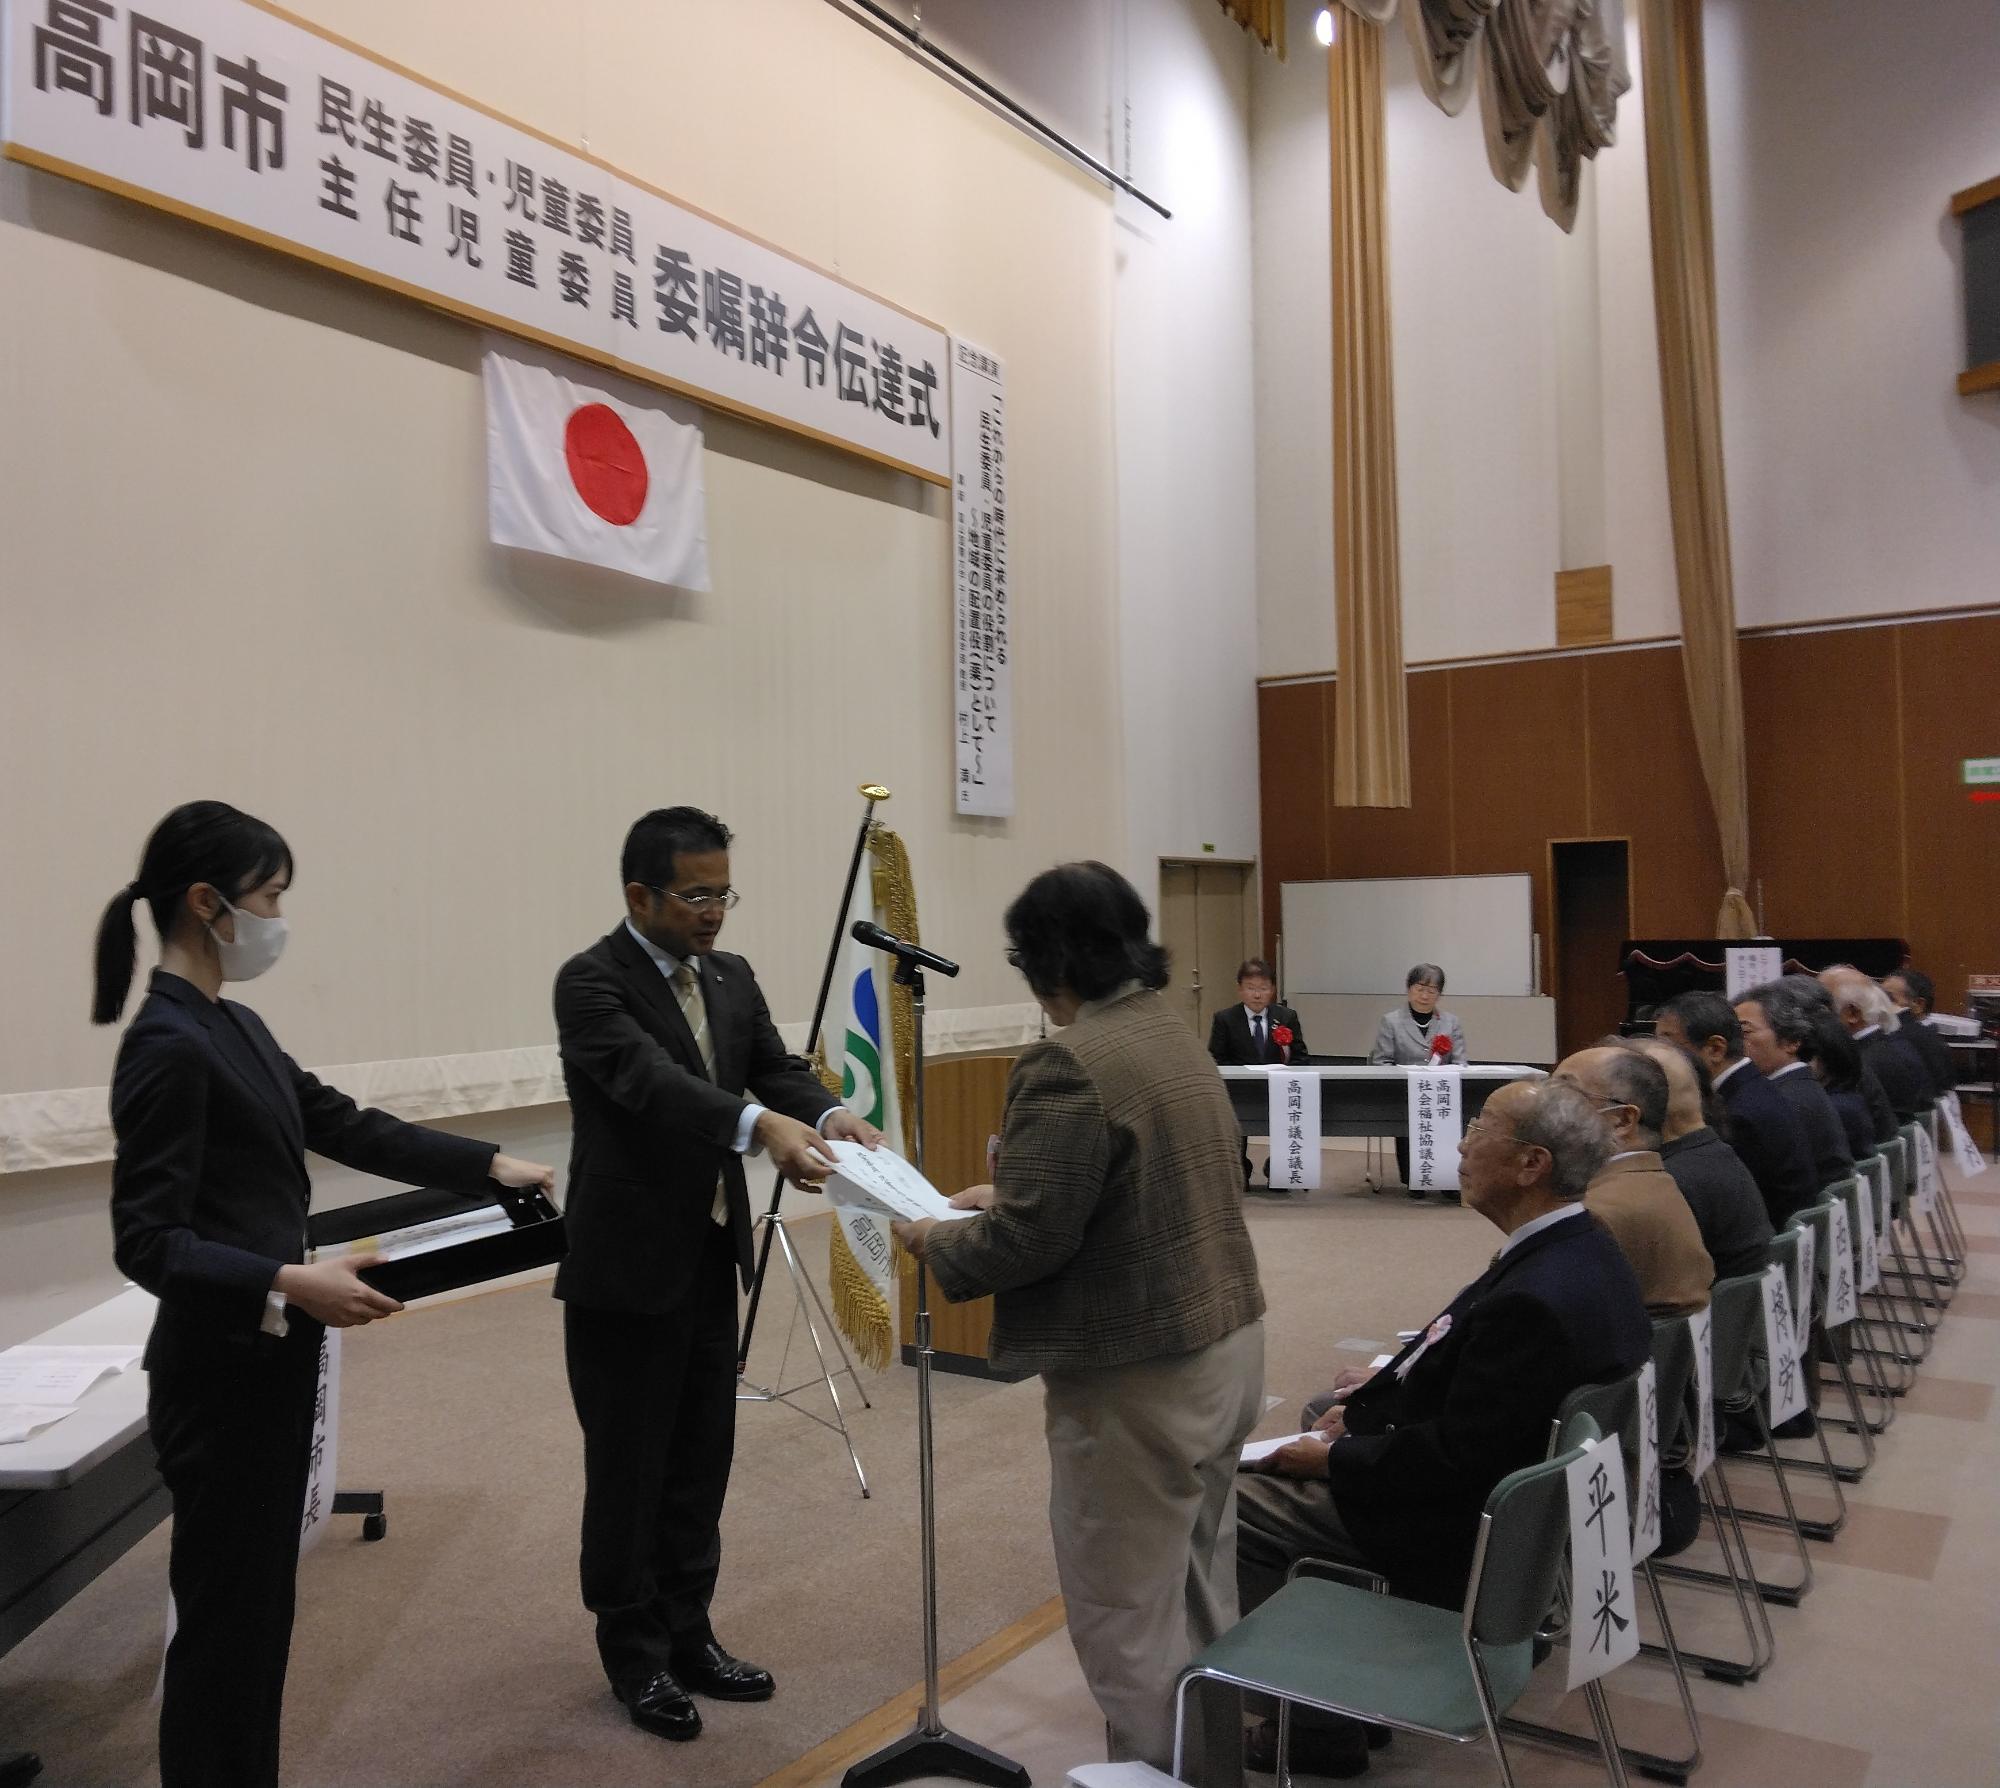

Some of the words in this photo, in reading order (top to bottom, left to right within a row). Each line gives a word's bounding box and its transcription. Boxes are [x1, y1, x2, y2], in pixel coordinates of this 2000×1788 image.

[33, 0, 287, 173] 高岡市
[317, 75, 634, 263] 民生委員・児童委員
[317, 158, 638, 328] 主任児童委員
[652, 245, 940, 438] 委嘱辞令伝達式
[1287, 1080, 1303, 1184] 高岡市議会議長
[1417, 1080, 1435, 1186] 社会福祉協議会長
[1436, 1079, 1450, 1119] 高岡市
[1584, 1461, 1629, 1656] 平米
